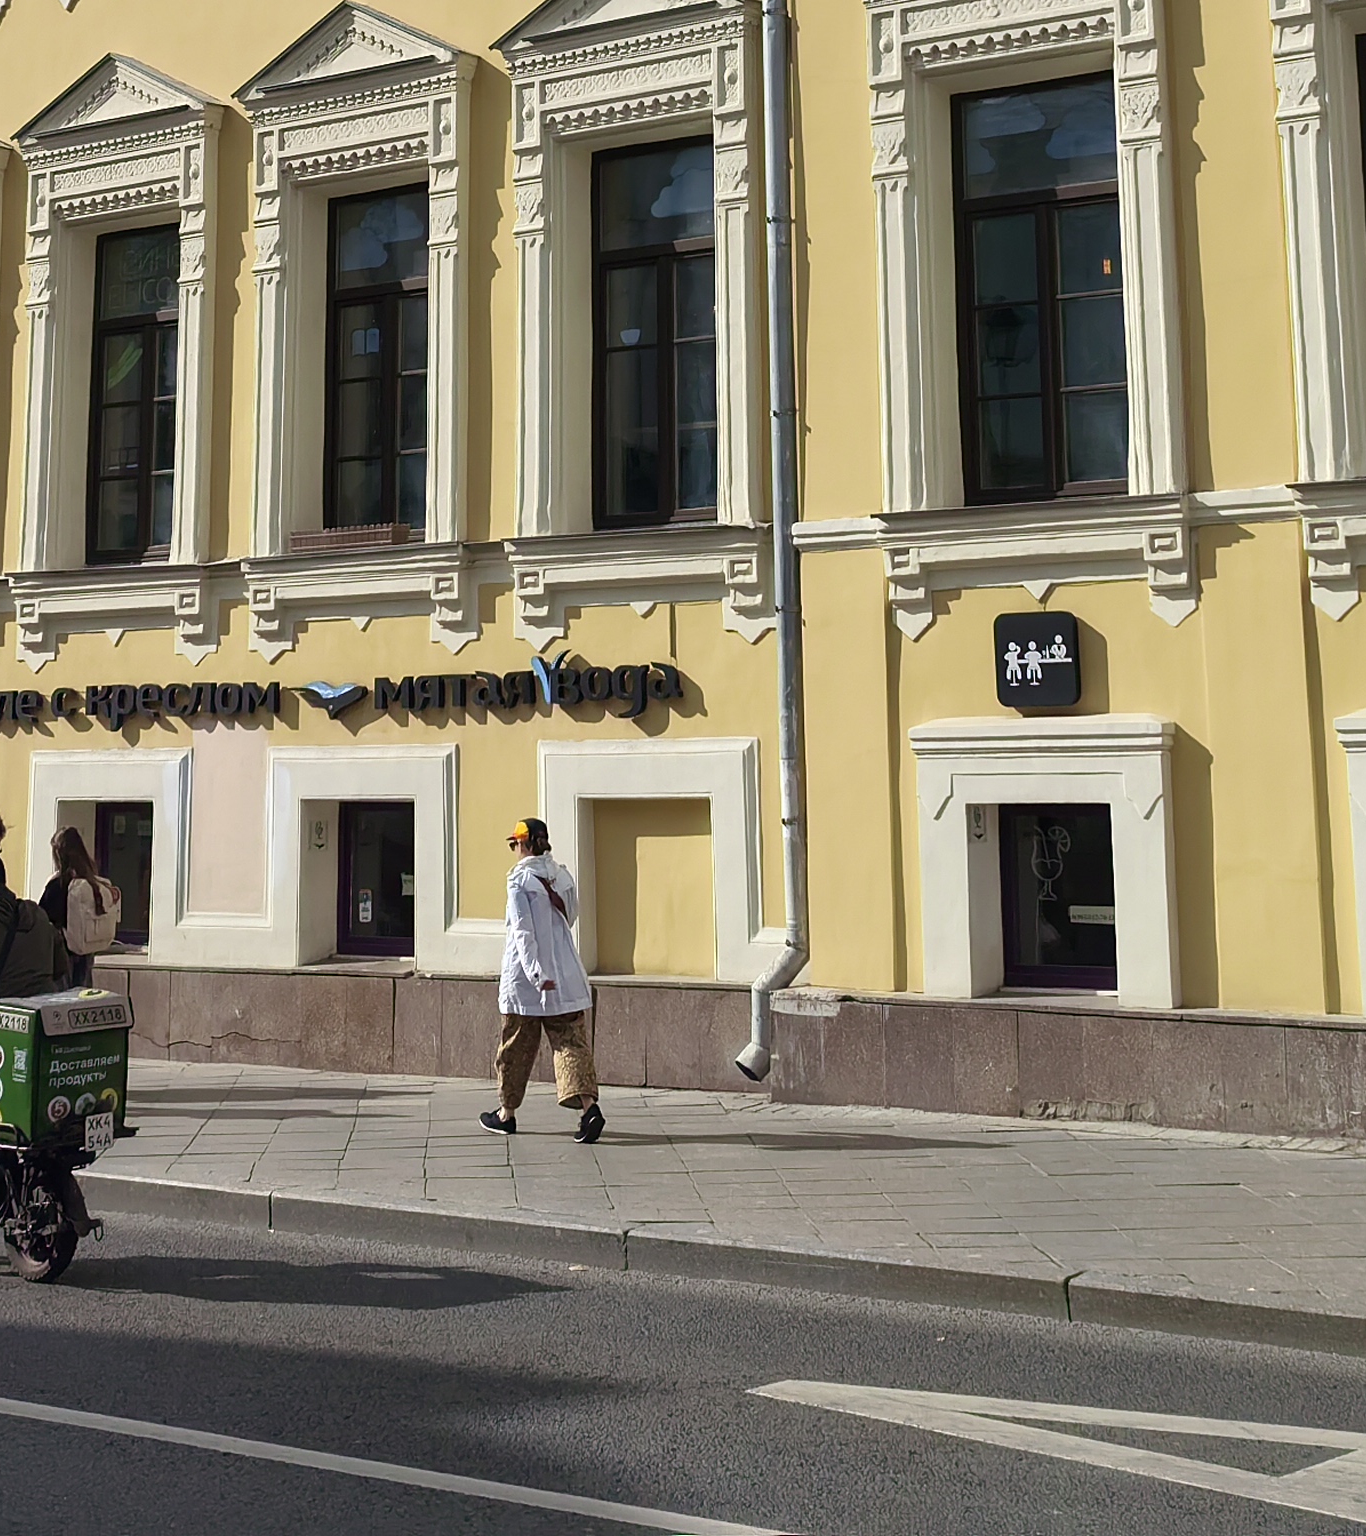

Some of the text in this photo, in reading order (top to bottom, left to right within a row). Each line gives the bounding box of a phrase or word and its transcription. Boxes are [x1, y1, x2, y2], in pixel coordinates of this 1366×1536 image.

[374, 670, 534, 710] мятая
[51, 691, 79, 718] с
[85, 680, 281, 732] креслом
[49, 1054, 121, 1074] Доставляем
[49, 1071, 107, 1089] продукты
